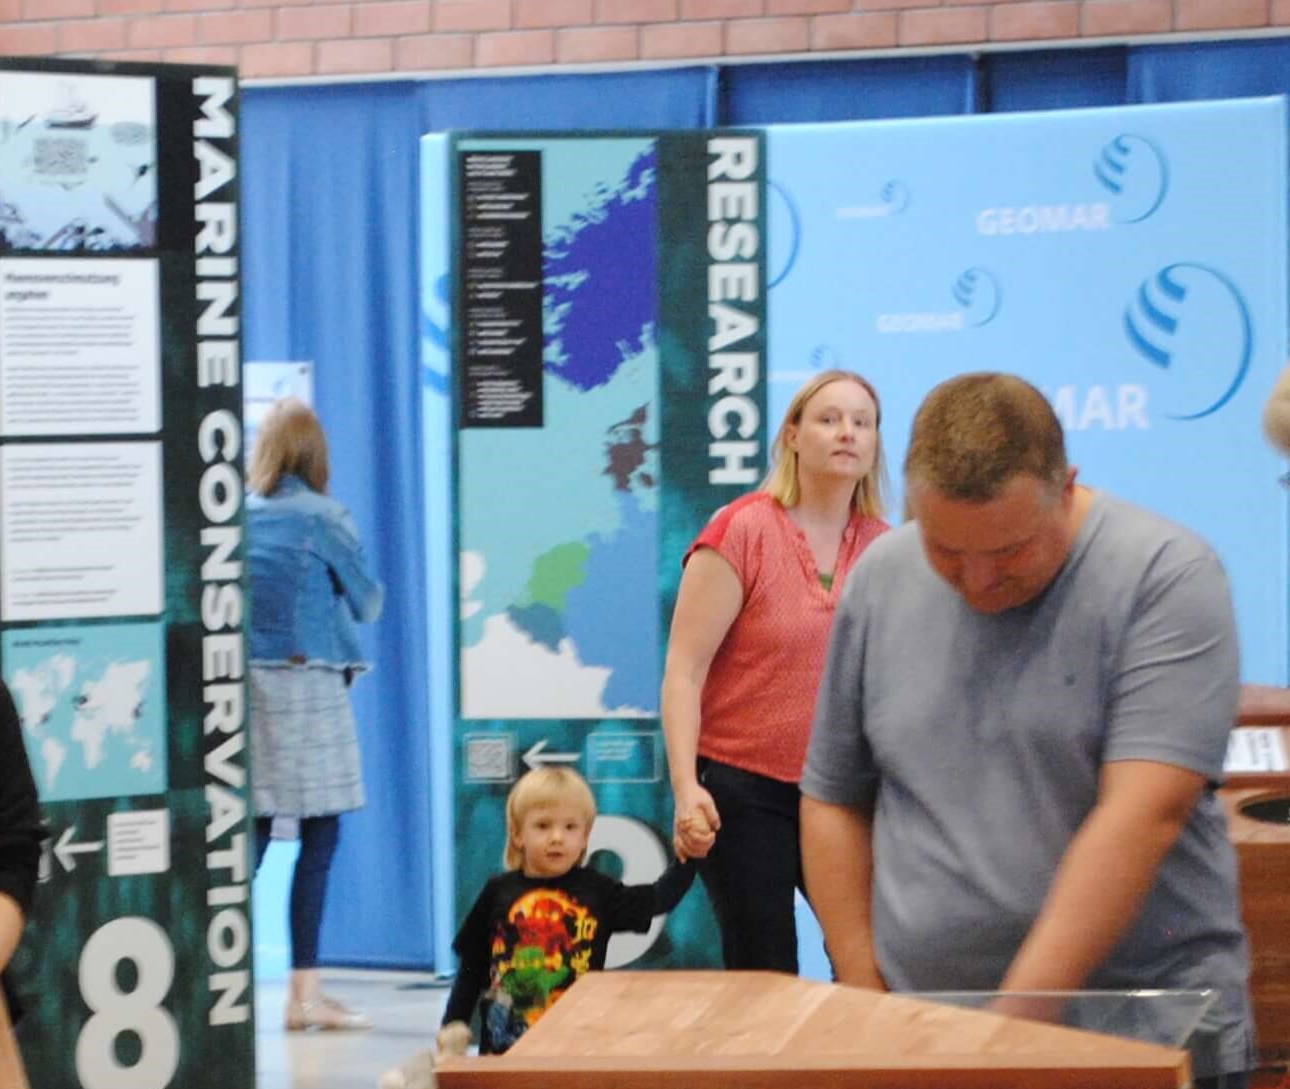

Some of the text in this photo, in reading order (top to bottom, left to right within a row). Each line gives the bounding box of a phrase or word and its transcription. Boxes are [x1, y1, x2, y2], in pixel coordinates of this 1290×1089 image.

[706, 136, 760, 485] RESEARCH
[976, 203, 1110, 235] GEOMAR
[1055, 384, 1148, 429] MAR
[192, 76, 250, 1026] MARINE CONSERVATION
